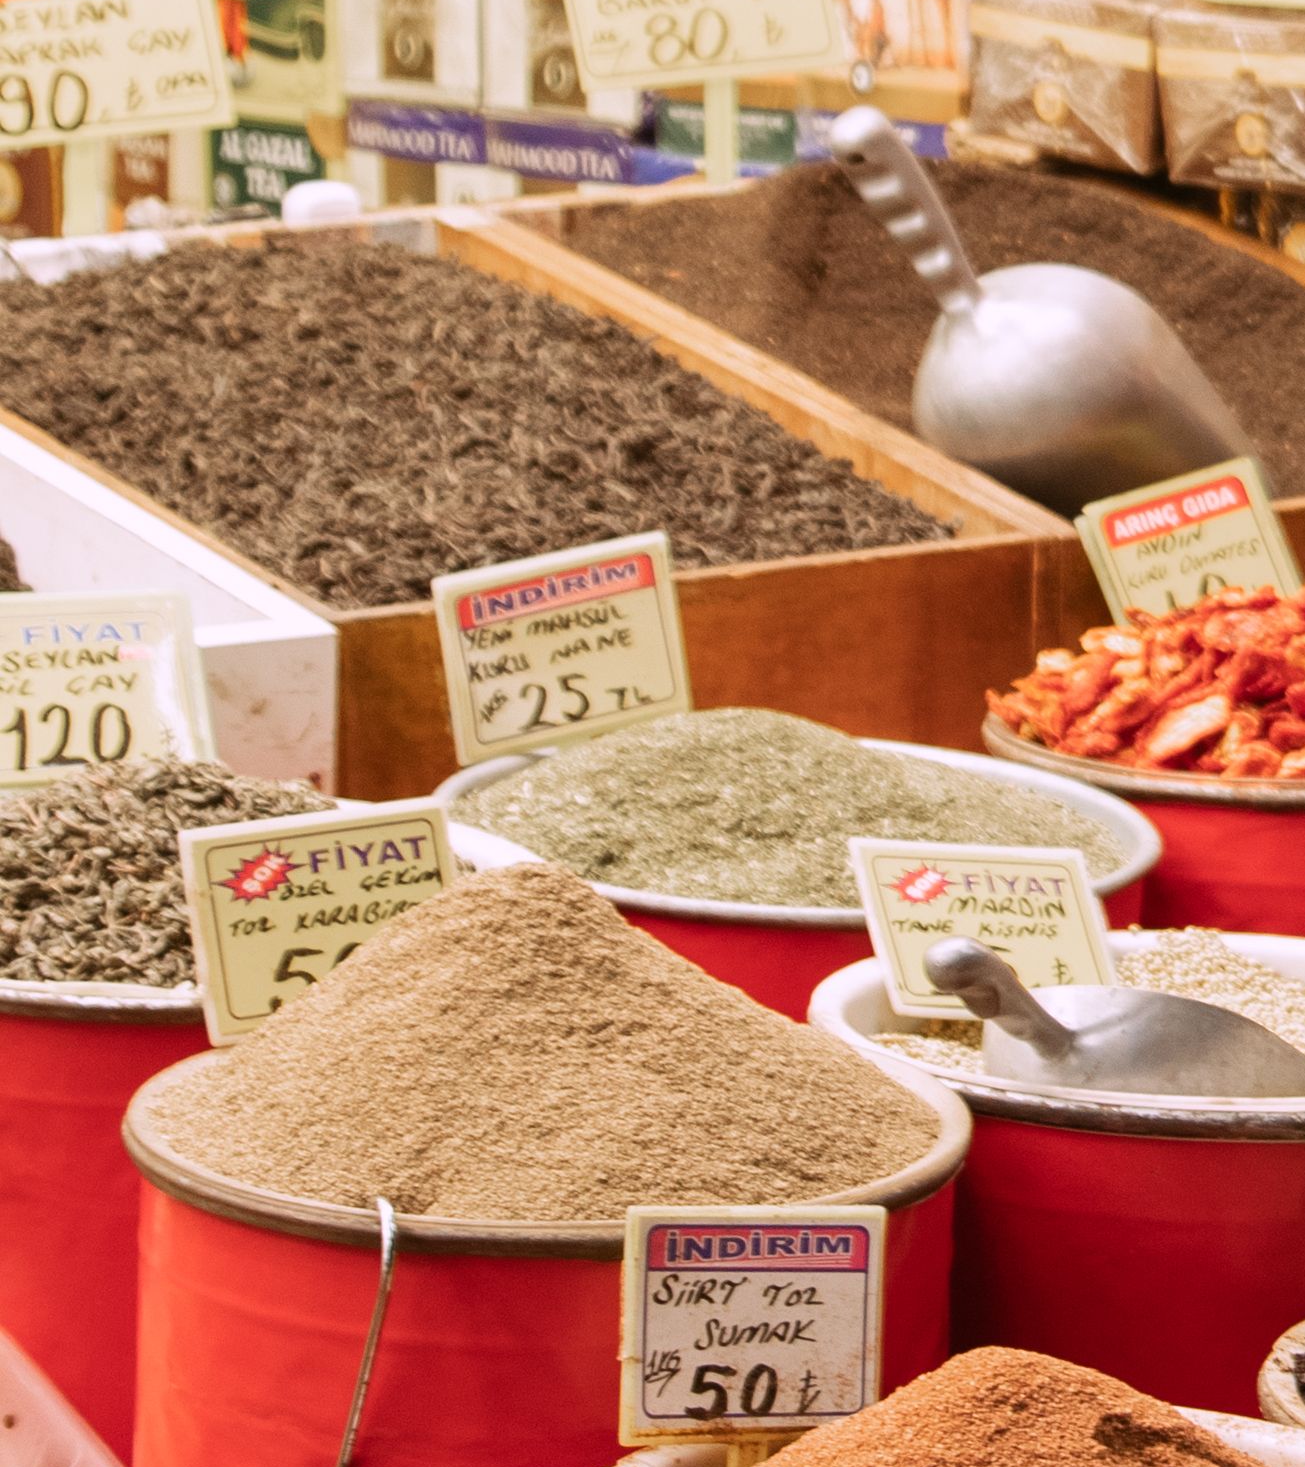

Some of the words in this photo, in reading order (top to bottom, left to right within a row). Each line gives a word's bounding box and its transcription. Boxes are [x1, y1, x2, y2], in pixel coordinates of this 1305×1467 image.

[1113, 503, 1180, 541] ARINÇ
[1182, 485, 1237, 518] GIDA
[471, 561, 639, 621] İNDİRİM
[468, 653, 532, 684] KURU
[517, 672, 592, 733] 25
[307, 835, 428, 874] FİYAT
[959, 868, 1066, 897] FİYAT
[228, 915, 278, 938] TOZ
[665, 1230, 852, 1263] İNDİRİM
[761, 1280, 825, 1308] TOZ
[693, 1316, 817, 1352] SUMAK
[683, 1362, 780, 1422] 50
